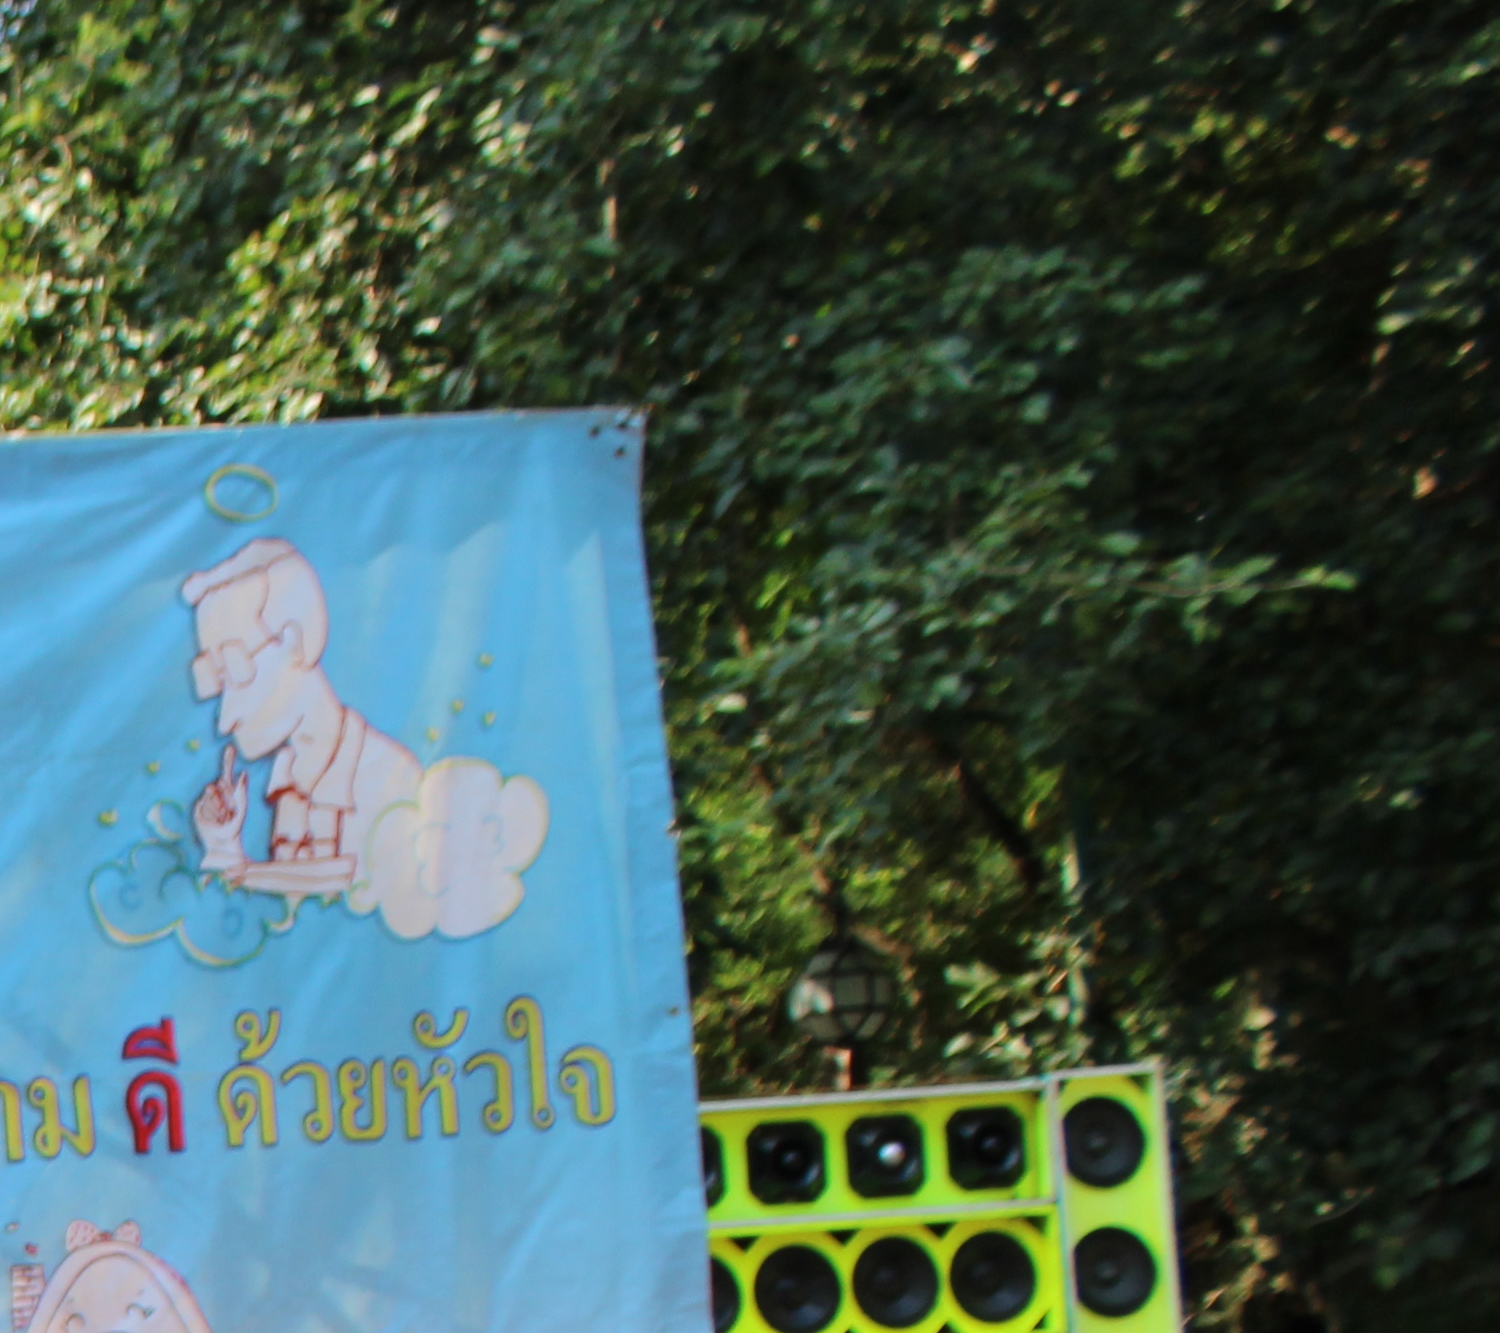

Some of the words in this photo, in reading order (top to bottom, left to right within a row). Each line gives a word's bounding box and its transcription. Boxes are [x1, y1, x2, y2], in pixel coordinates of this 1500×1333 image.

[120, 1018, 188, 1156] ดี
[216, 994, 617, 1150] ด้วยหัวใจ
